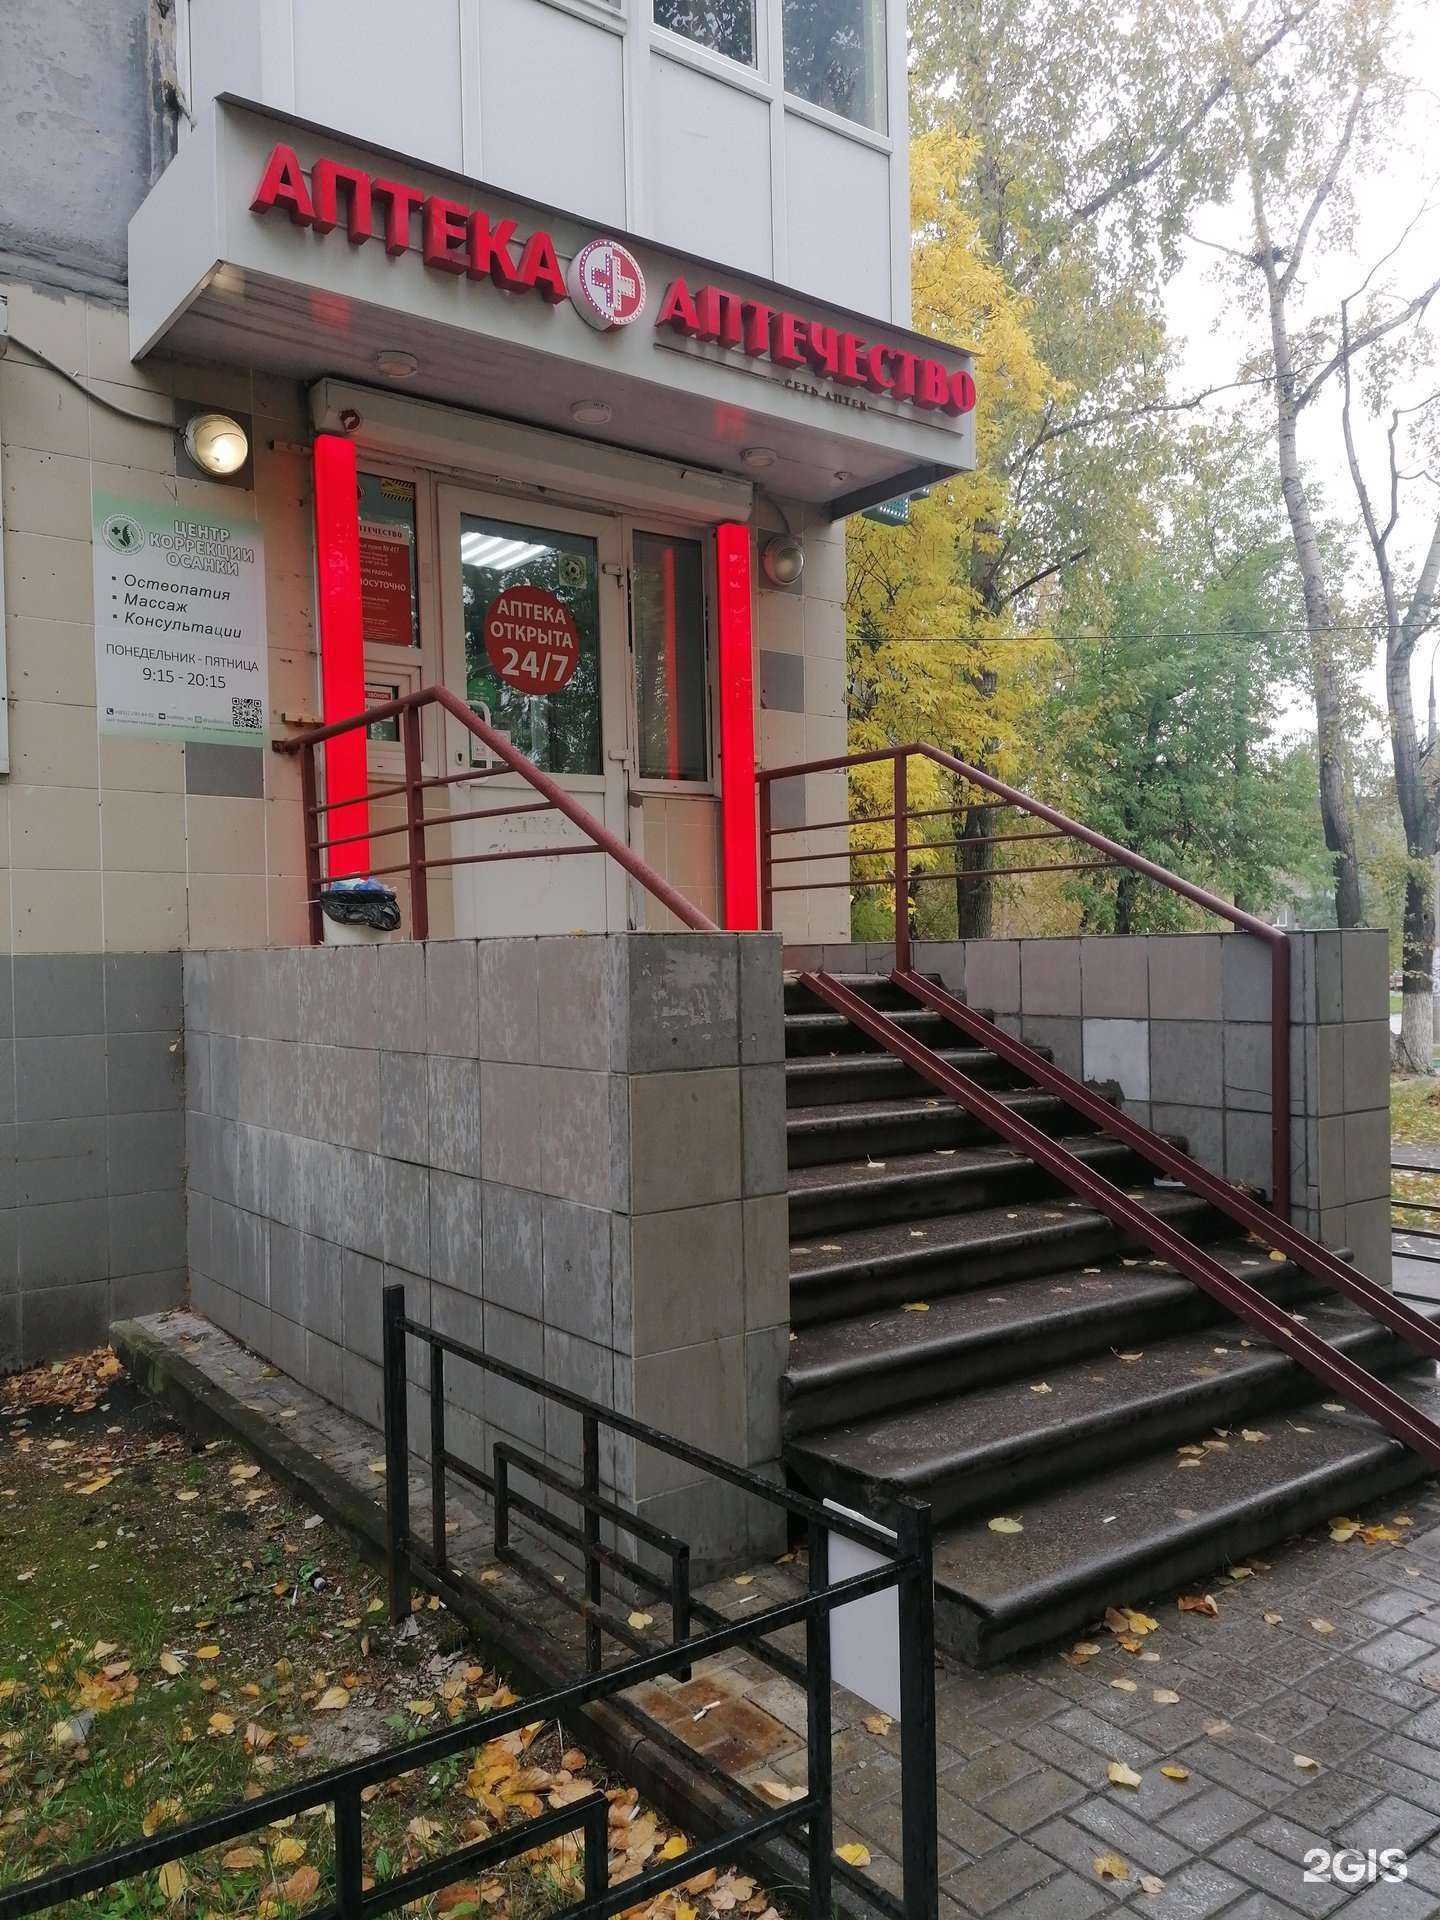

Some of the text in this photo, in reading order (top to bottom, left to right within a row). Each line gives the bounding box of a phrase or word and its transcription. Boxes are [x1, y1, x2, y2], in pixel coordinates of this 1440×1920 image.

[249, 143, 568, 305] АПТЕКА
[655, 276, 977, 418] АПТЕЧЕСТВО
[784, 378, 818, 397] СЕТЬ
[173, 519, 231, 543] ЦЕНТР
[150, 532, 255, 563] КОРРЕКЦИИ
[166, 552, 239, 576] ОСАНКИ
[124, 574, 231, 601] Остеопатия
[124, 592, 189, 614] Массаж
[497, 599, 567, 625] АПТЕКА
[124, 612, 243, 639] Консультации
[490, 621, 574, 649] ОТКРЫТА
[106, 643, 196, 664] ПОНЕДЕЛЬНИК
[205, 655, 259, 673] ПЯТНИЦА
[502, 647, 569, 682] 24/7
[142, 668, 175, 683] 9:15
[187, 673, 226, 689] 20:15
